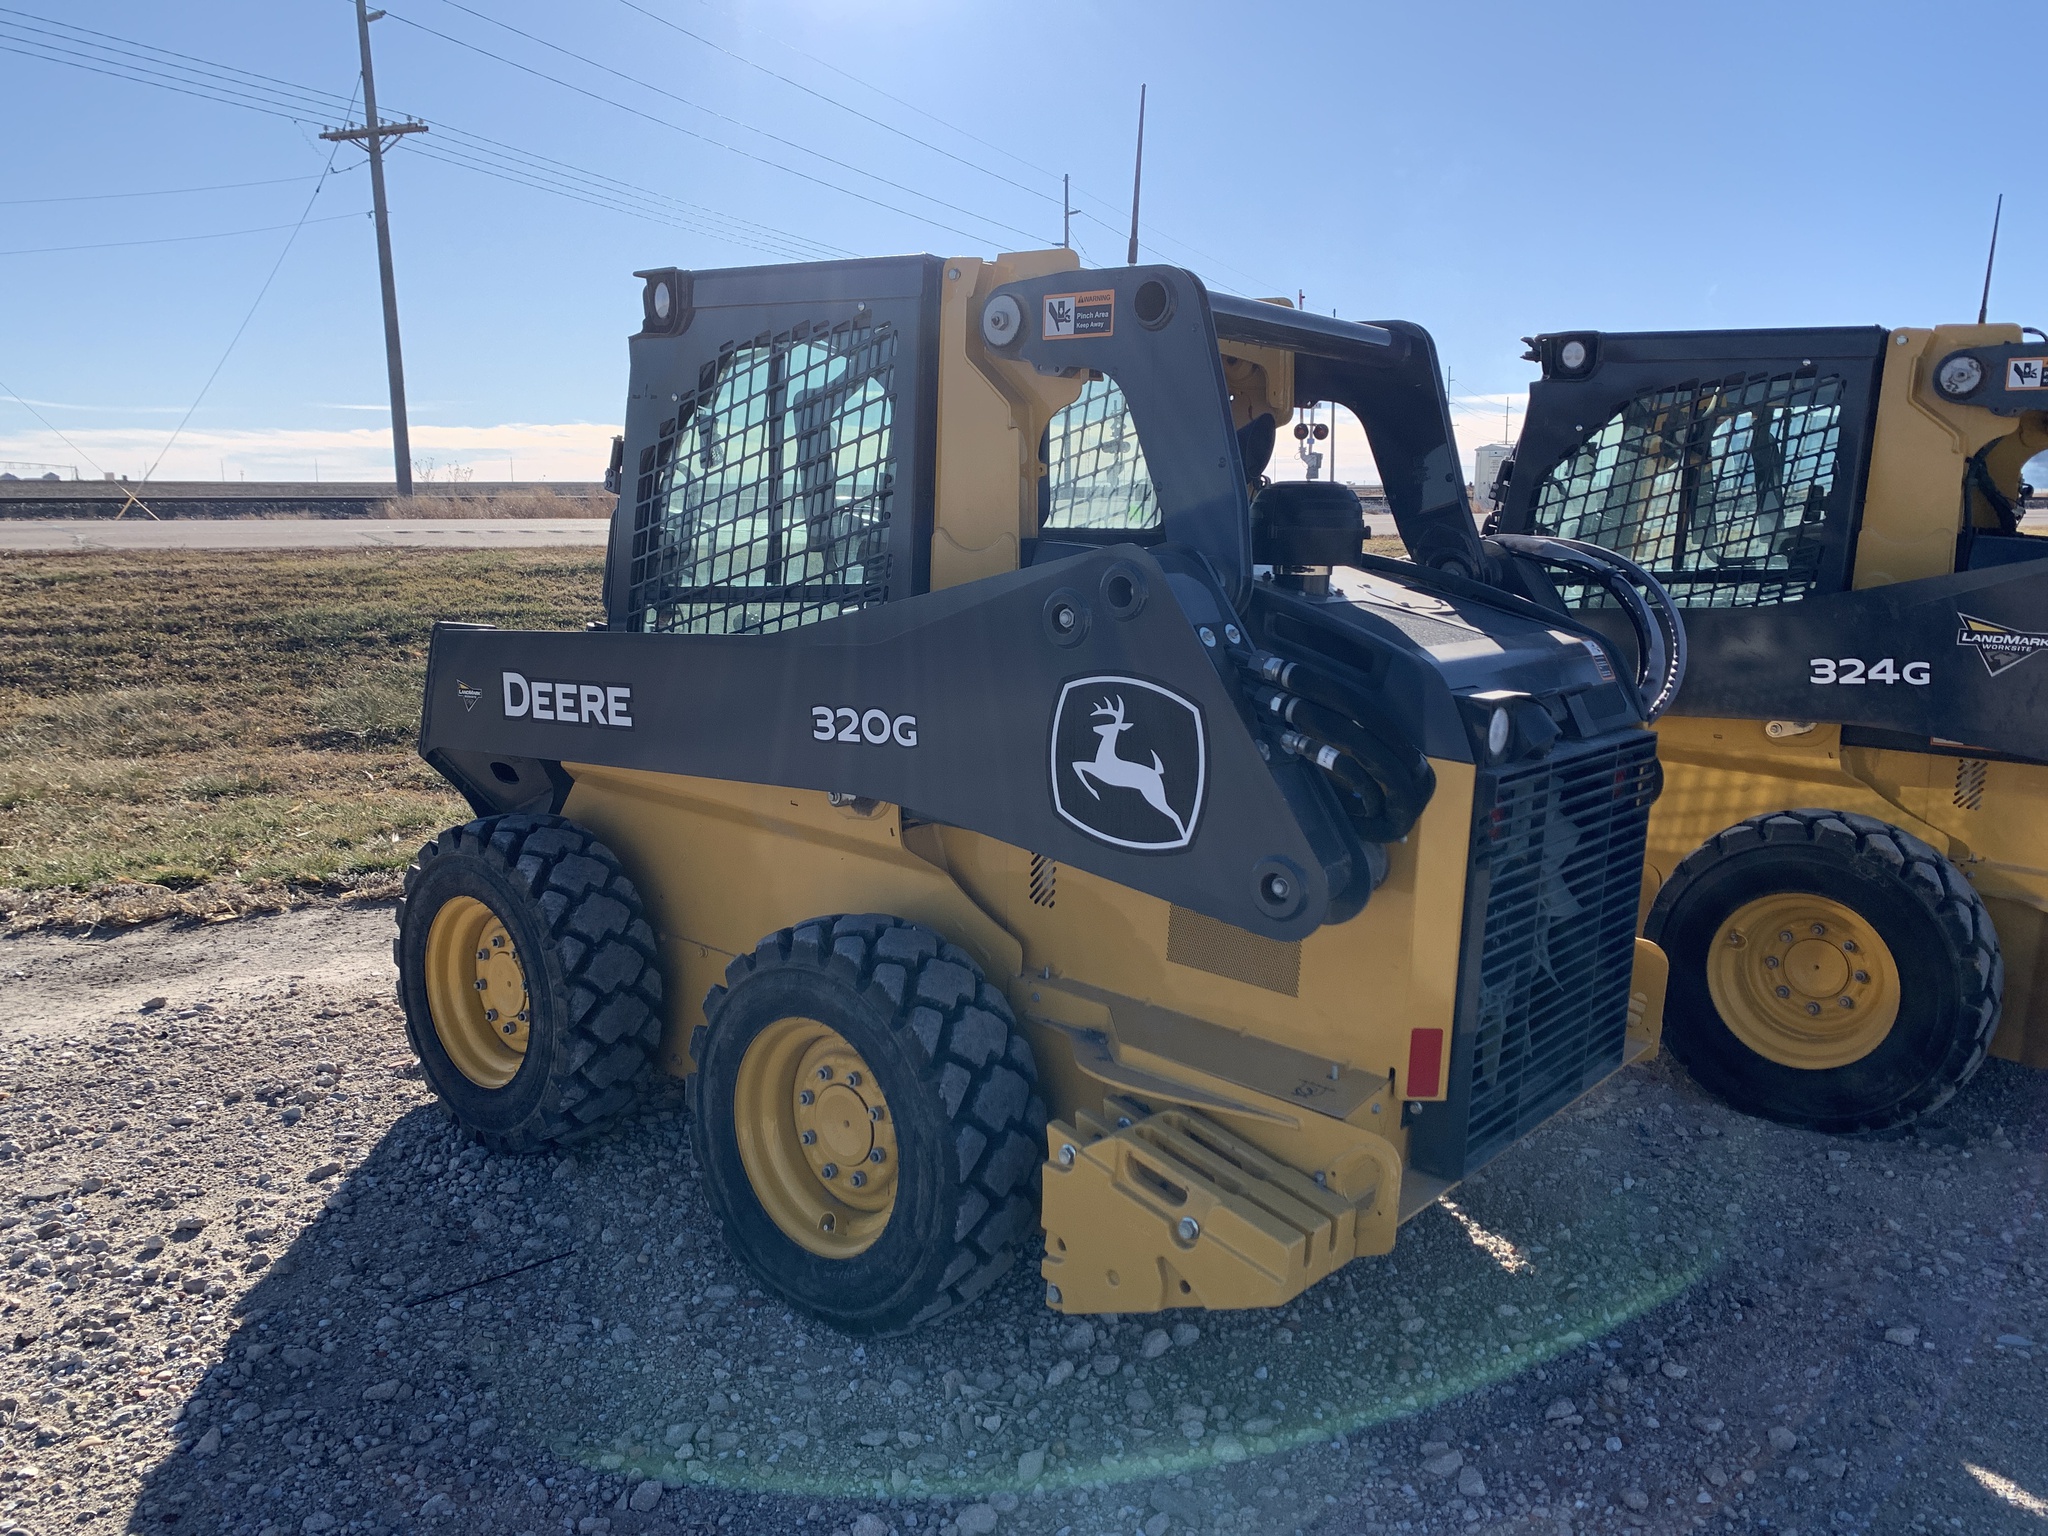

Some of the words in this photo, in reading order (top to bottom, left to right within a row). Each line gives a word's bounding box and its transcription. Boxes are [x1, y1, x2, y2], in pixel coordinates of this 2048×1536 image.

[1083, 294, 1111, 302] WARNING
[1076, 312, 1094, 320] Pinch
[1961, 632, 2048, 646] LANDMARK
[1982, 643, 2032, 652] WORKSITE
[1809, 658, 1930, 685] 324G
[502, 671, 633, 727] DEERE
[811, 706, 918, 747] 320G
